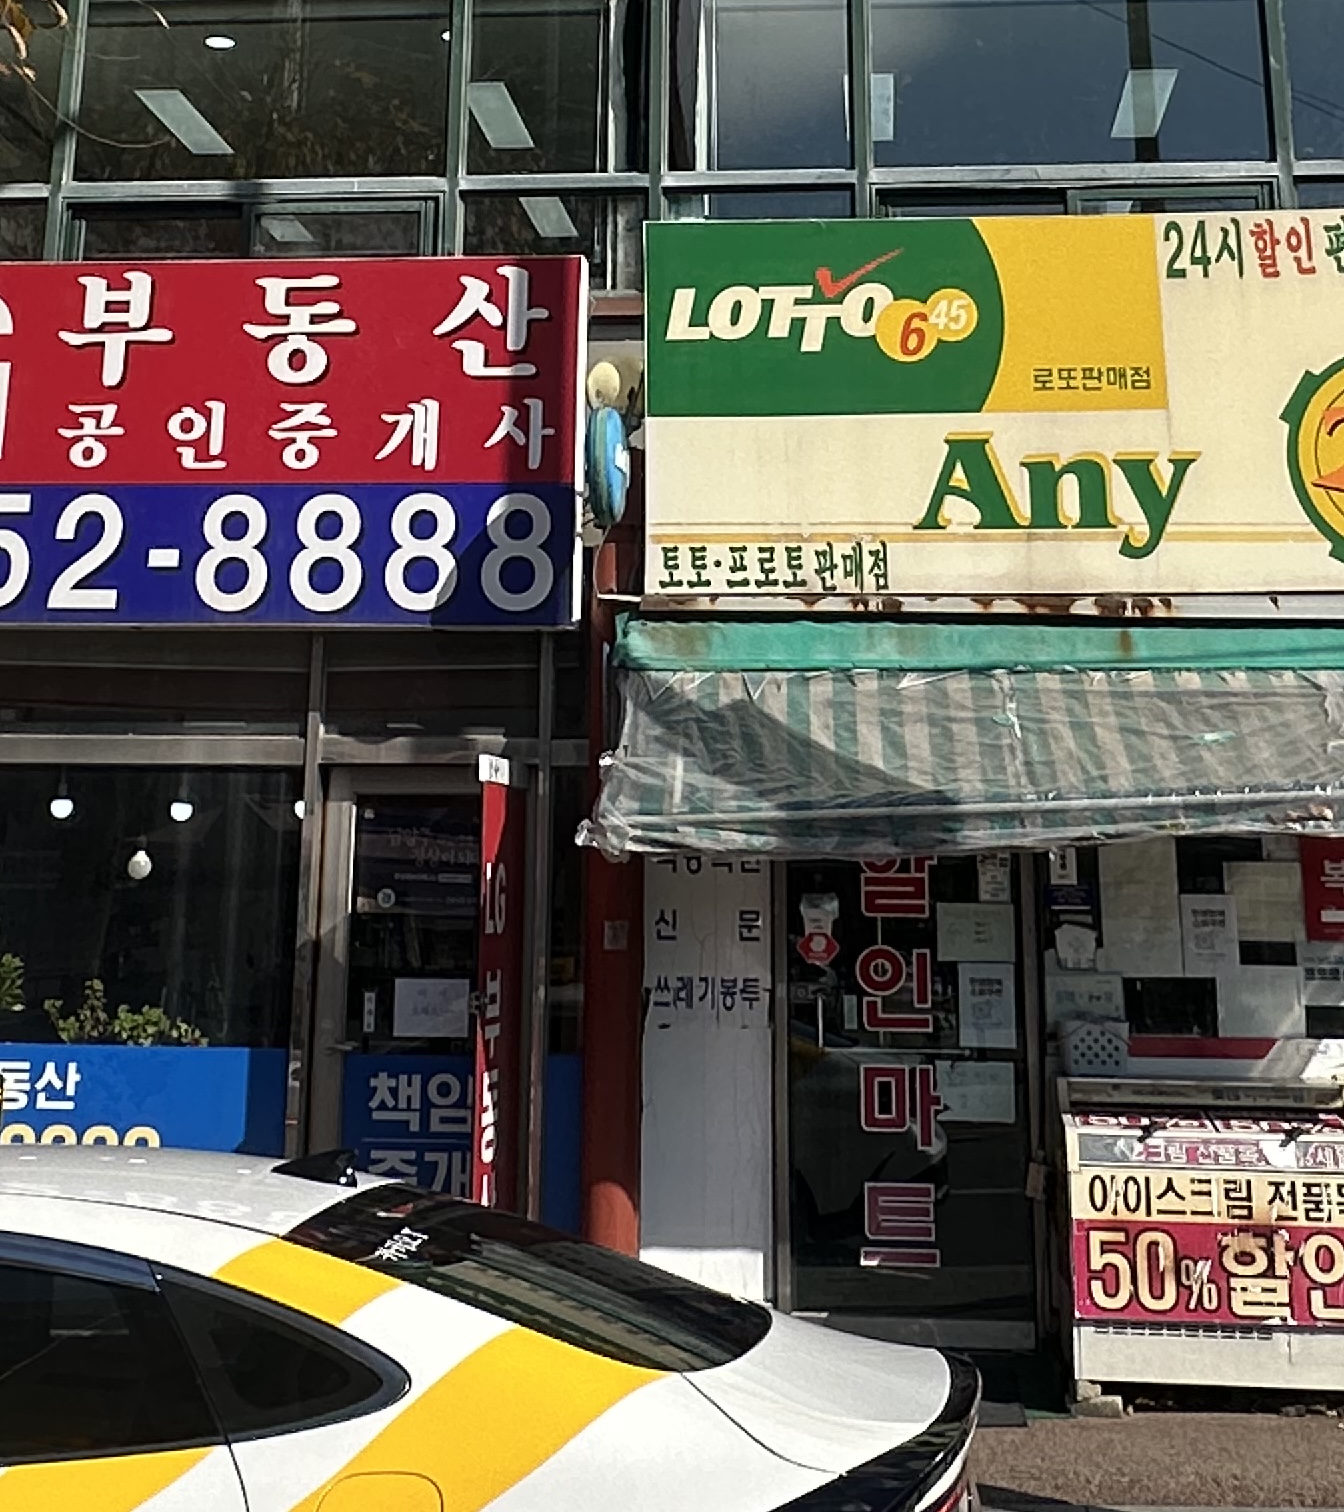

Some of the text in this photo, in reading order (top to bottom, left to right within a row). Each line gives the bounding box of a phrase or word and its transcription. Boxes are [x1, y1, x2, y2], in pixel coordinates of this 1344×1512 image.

[58, 265, 555, 387] 부동산
[665, 282, 970, 357] LOTTO 6 45
[1031, 365, 1153, 393] 로또판매점
[58, 399, 555, 471] 공인중개사
[913, 430, 1202, 560] Any
[652, 975, 762, 1011] 쓰레기봉투
[367, 1070, 473, 1133] 책임
[1088, 1177, 1254, 1220] 아이스크림
[1087, 1229, 1218, 1312] 50%
